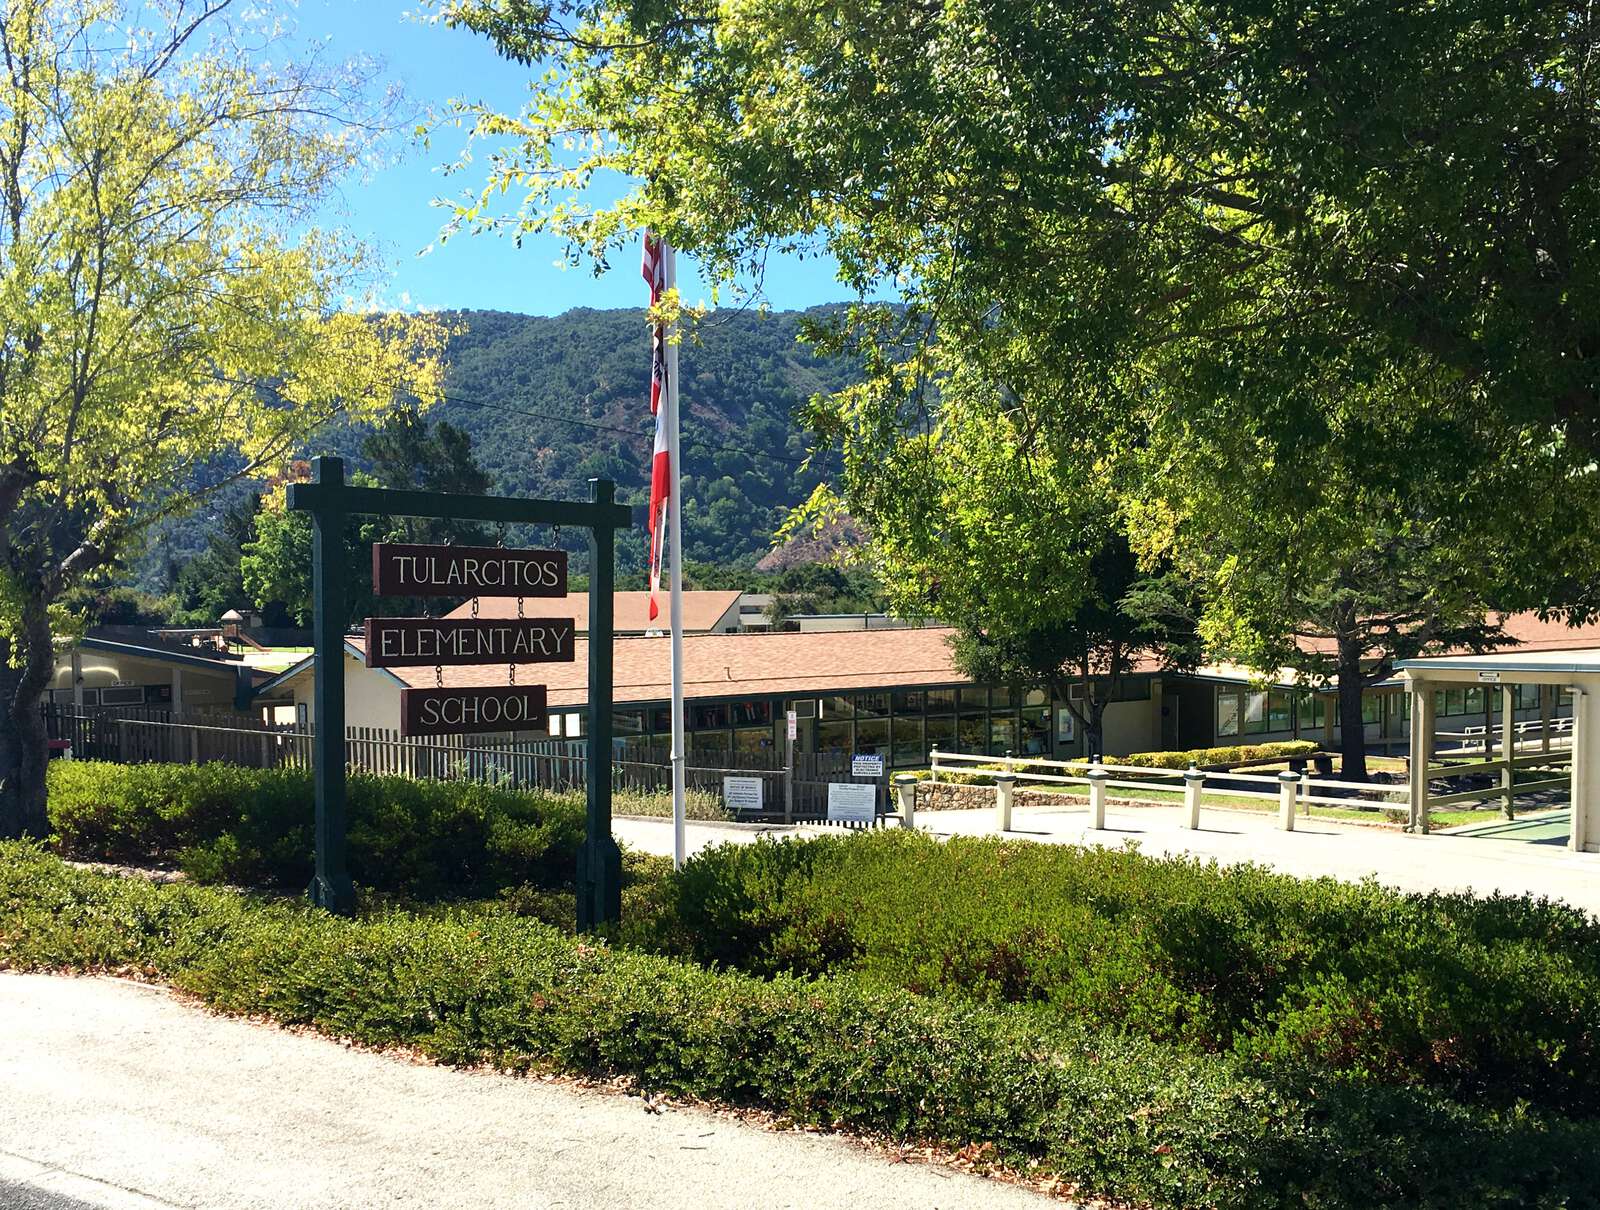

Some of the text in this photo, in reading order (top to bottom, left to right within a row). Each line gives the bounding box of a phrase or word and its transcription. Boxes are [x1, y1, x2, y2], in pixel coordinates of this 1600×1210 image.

[392, 556, 559, 587] TULARCITOS
[381, 627, 569, 657] ELEMENTARY
[420, 695, 538, 726] SCHOOL
